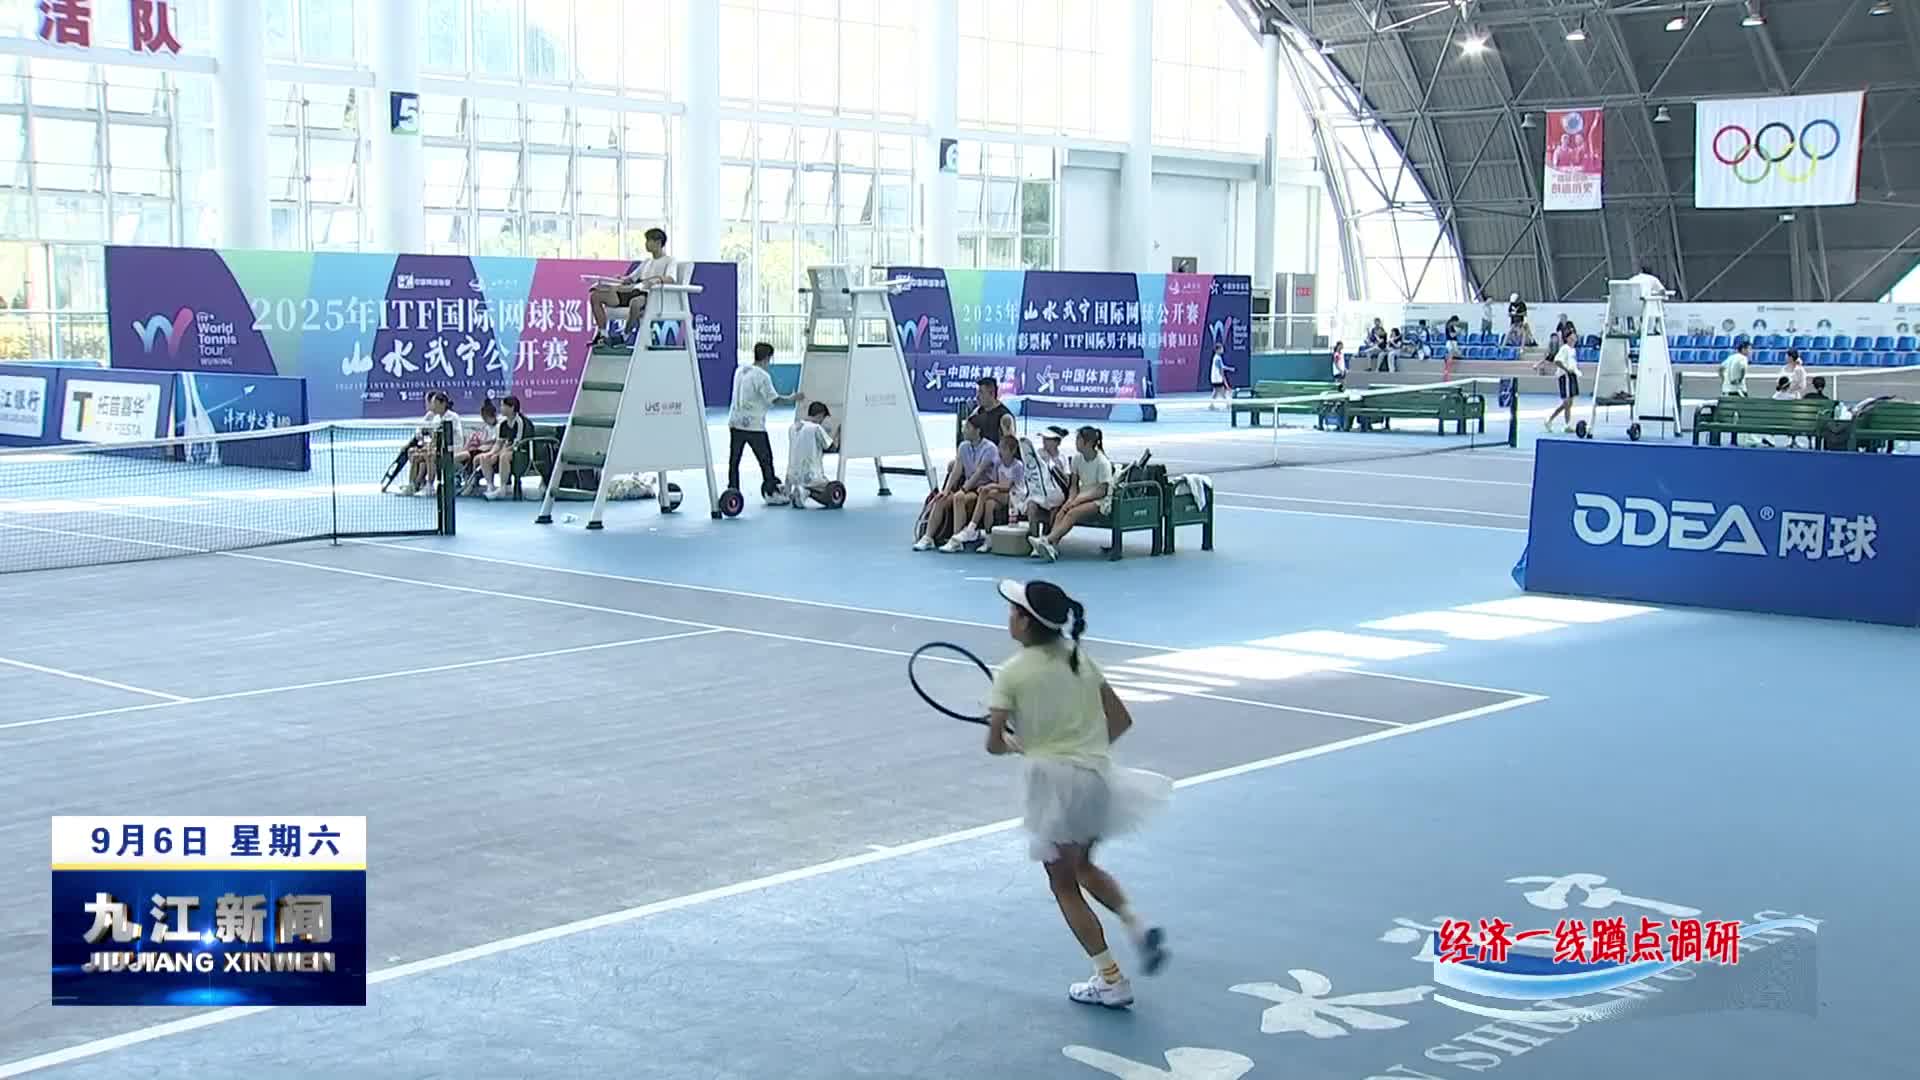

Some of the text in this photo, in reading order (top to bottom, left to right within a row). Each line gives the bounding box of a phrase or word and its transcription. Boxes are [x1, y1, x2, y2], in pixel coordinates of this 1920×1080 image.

[39, 0, 182, 54] 活队
[197, 322, 233, 334] World
[199, 345, 225, 356] Tour
[341, 335, 569, 378] 山水武宁公开赛
[948, 365, 1017, 381] 中国体育彩票
[1061, 368, 1136, 385] 中国体育彩票
[1779, 511, 1879, 564] 网球
